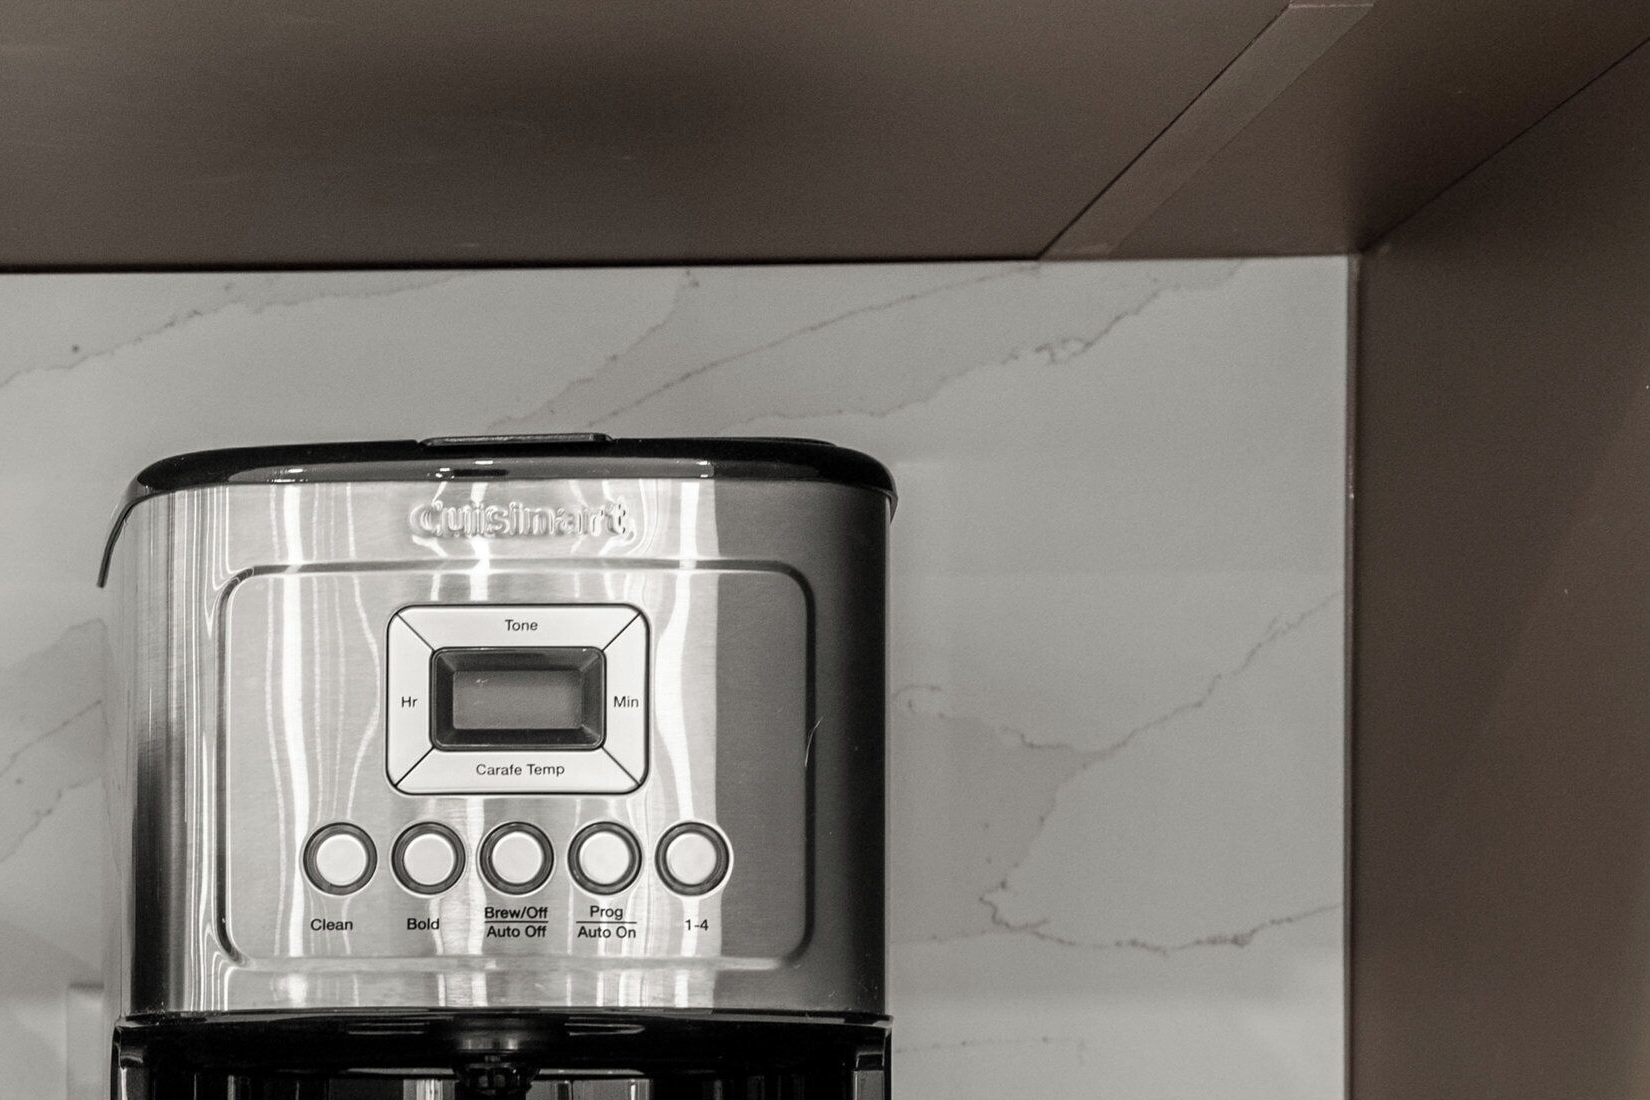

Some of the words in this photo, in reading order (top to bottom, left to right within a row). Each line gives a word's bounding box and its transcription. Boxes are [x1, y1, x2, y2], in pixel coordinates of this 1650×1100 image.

[409, 498, 630, 538] Cuisinart
[504, 619, 539, 632] Tone
[401, 696, 418, 708] Hr
[613, 695, 639, 708] Min
[476, 763, 523, 776] Carafe
[526, 763, 565, 778] Temp
[484, 906, 549, 919] Brew/Off
[589, 905, 624, 921] Prog
[310, 918, 354, 931] Clean
[406, 917, 440, 931] Bold
[685, 918, 709, 931] 1-4
[486, 925, 521, 938] Auto
[525, 925, 548, 938] Off
[577, 925, 612, 938] Auto
[615, 925, 637, 938] On
